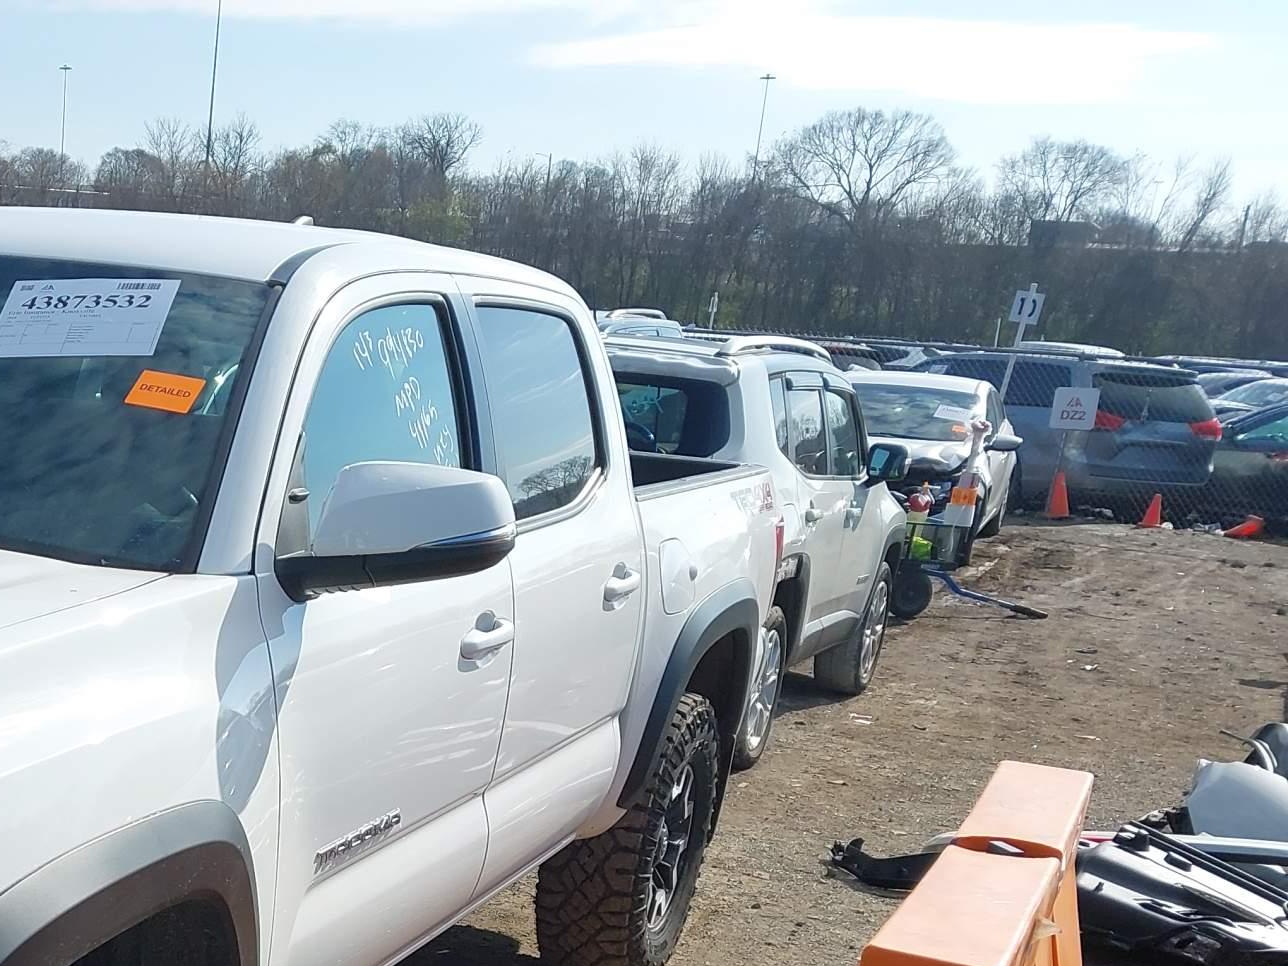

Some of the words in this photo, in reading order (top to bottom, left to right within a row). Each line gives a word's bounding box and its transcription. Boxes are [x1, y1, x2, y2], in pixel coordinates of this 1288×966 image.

[21, 294, 152, 310] 43873532
[139, 383, 191, 398] DETAILED
[1060, 410, 1087, 421] DZ2
